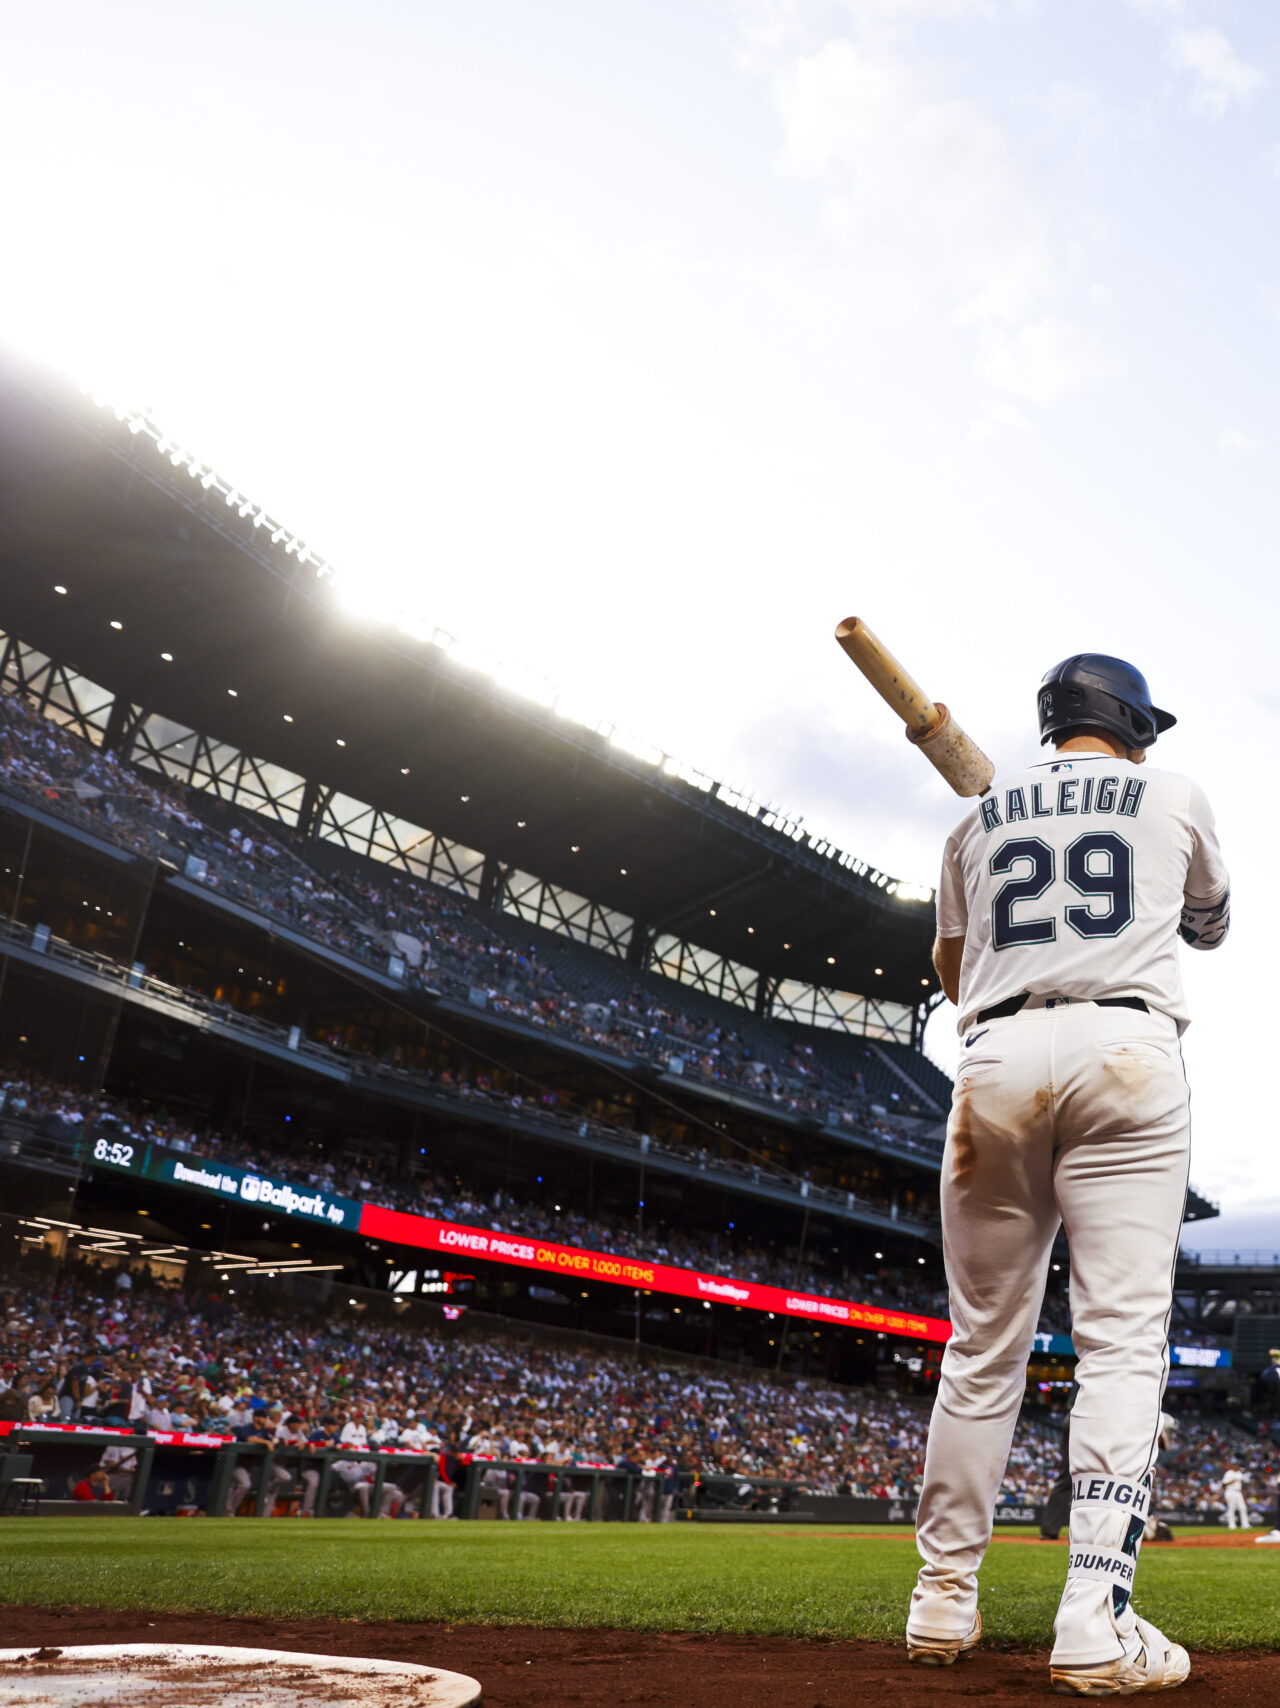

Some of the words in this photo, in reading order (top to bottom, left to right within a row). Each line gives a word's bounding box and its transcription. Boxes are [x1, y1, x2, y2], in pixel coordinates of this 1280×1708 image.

[979, 776, 1147, 833] RALEIGH
[990, 831, 1135, 952] 29
[94, 1138, 134, 1167] 8:52
[173, 1162, 222, 1190] Download
[222, 1176, 238, 1194] the
[259, 1181, 326, 1214] Ballpark
[327, 1204, 345, 1224] App
[439, 1229, 488, 1251] LOWER
[490, 1239, 535, 1260] PRICES
[536, 1248, 556, 1264] ON
[557, 1252, 590, 1269] OVER
[593, 1260, 622, 1277] 1,000
[623, 1266, 655, 1283] ITEMS
[786, 1297, 818, 1314] LOWER
[819, 1301, 849, 1319] PRICES
[994, 1507, 1035, 1520] LEXUS
[1074, 1553, 1134, 1583] DUMPER
